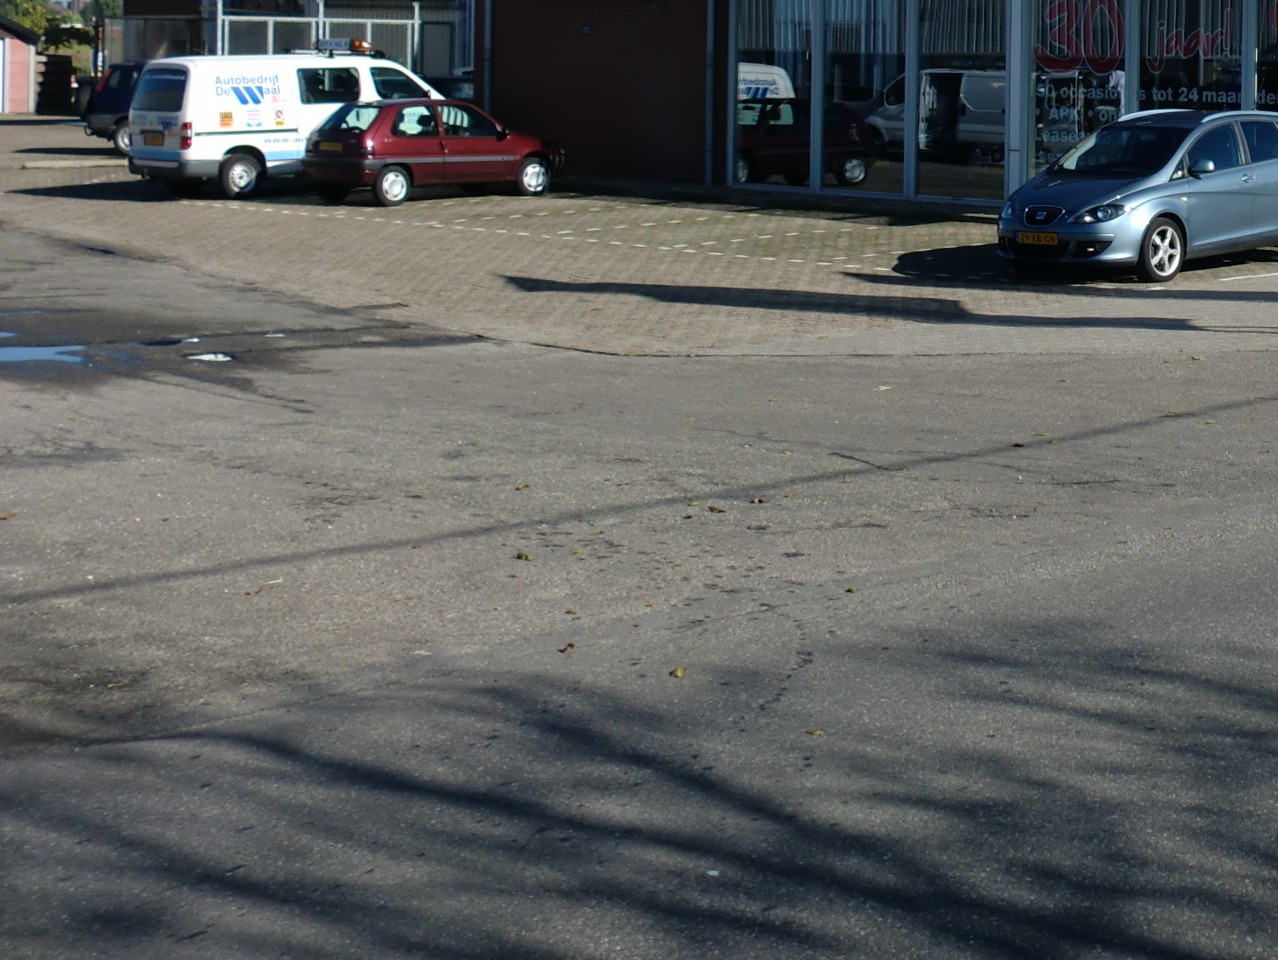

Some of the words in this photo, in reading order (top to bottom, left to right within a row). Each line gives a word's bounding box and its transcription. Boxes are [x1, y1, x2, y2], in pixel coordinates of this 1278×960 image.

[1146, 8, 1232, 73] jaar!
[215, 74, 279, 86] Autobedrijf
[1036, 83, 1055, 98] 50
[1060, 86, 1146, 101] occasios
[1152, 87, 1173, 102] tot
[1178, 87, 1198, 103] 24
